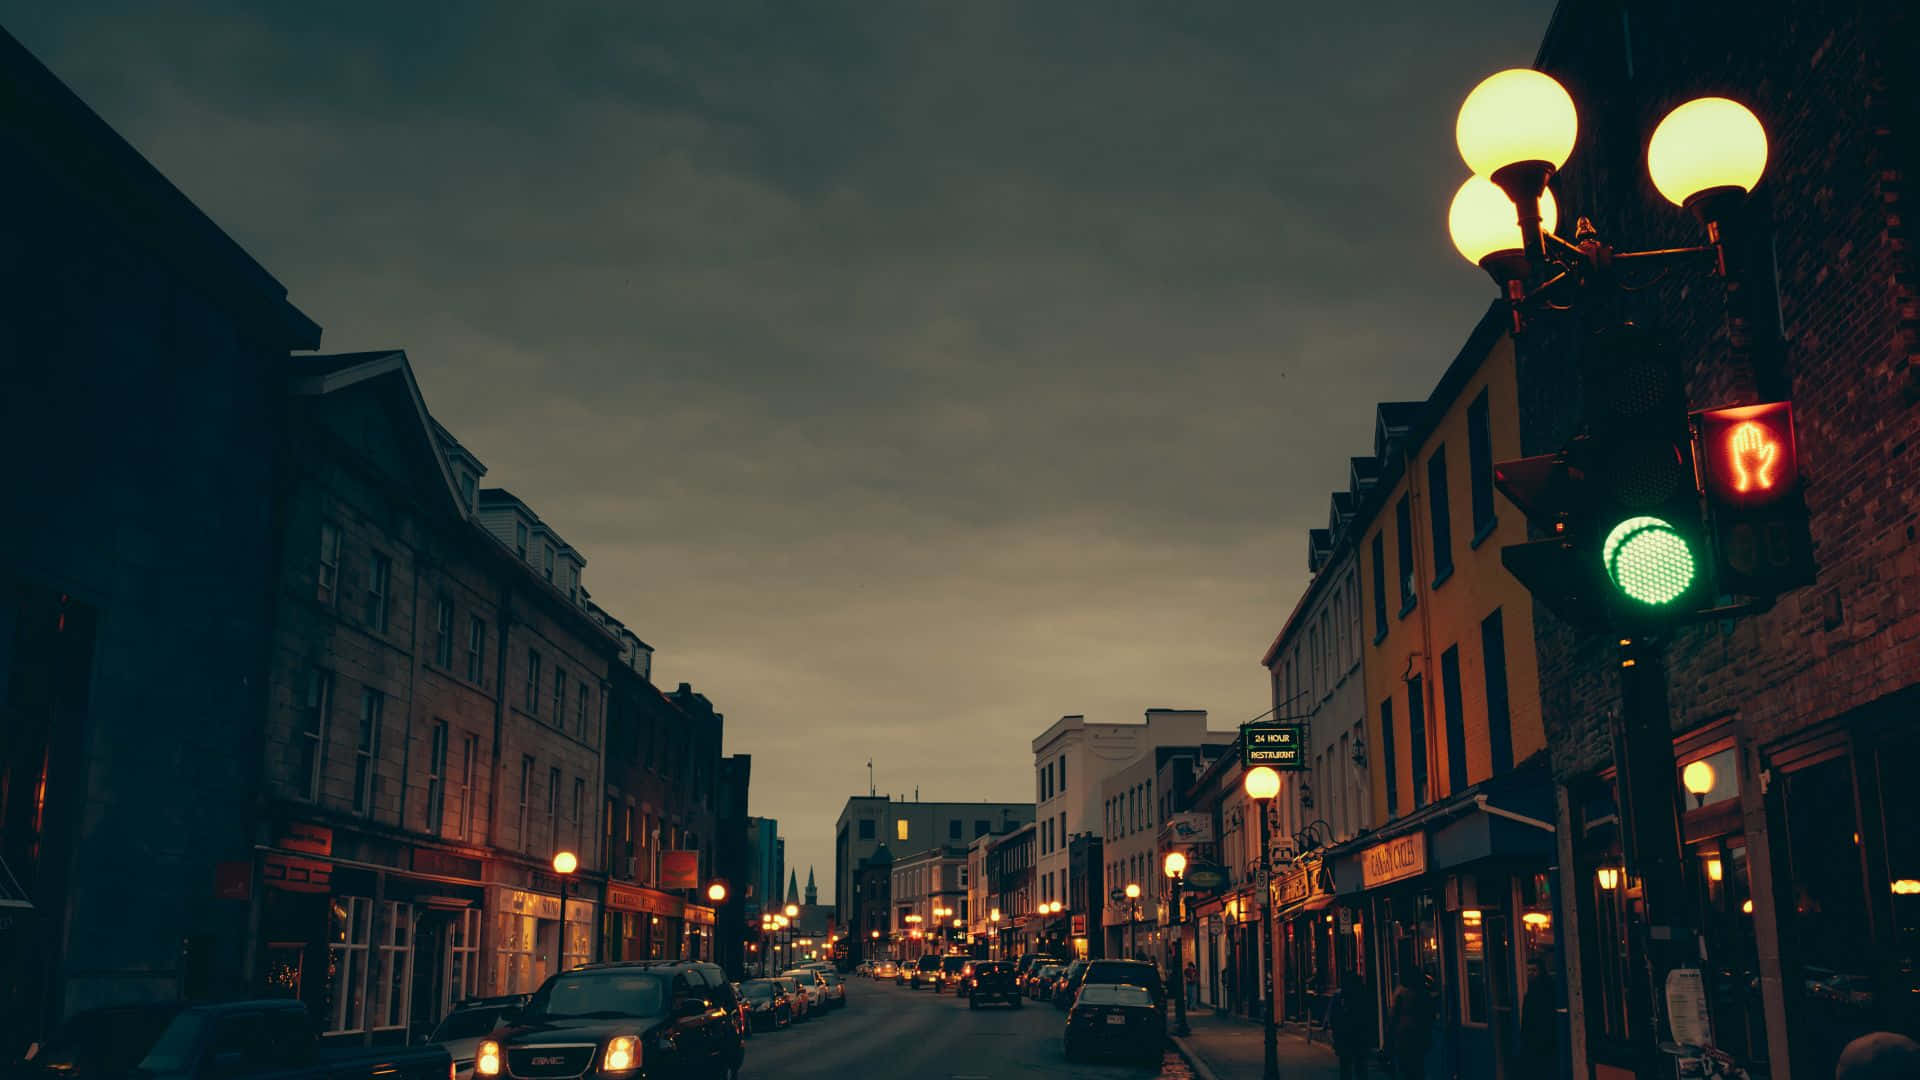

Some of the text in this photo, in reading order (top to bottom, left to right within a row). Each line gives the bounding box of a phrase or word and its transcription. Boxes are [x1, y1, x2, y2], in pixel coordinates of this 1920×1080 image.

[1255, 735, 1290, 743] 24 HOUR
[1251, 751, 1296, 760] RESTAURANT
[1393, 839, 1416, 870] CYCLES
[531, 1056, 565, 1065] GMC
